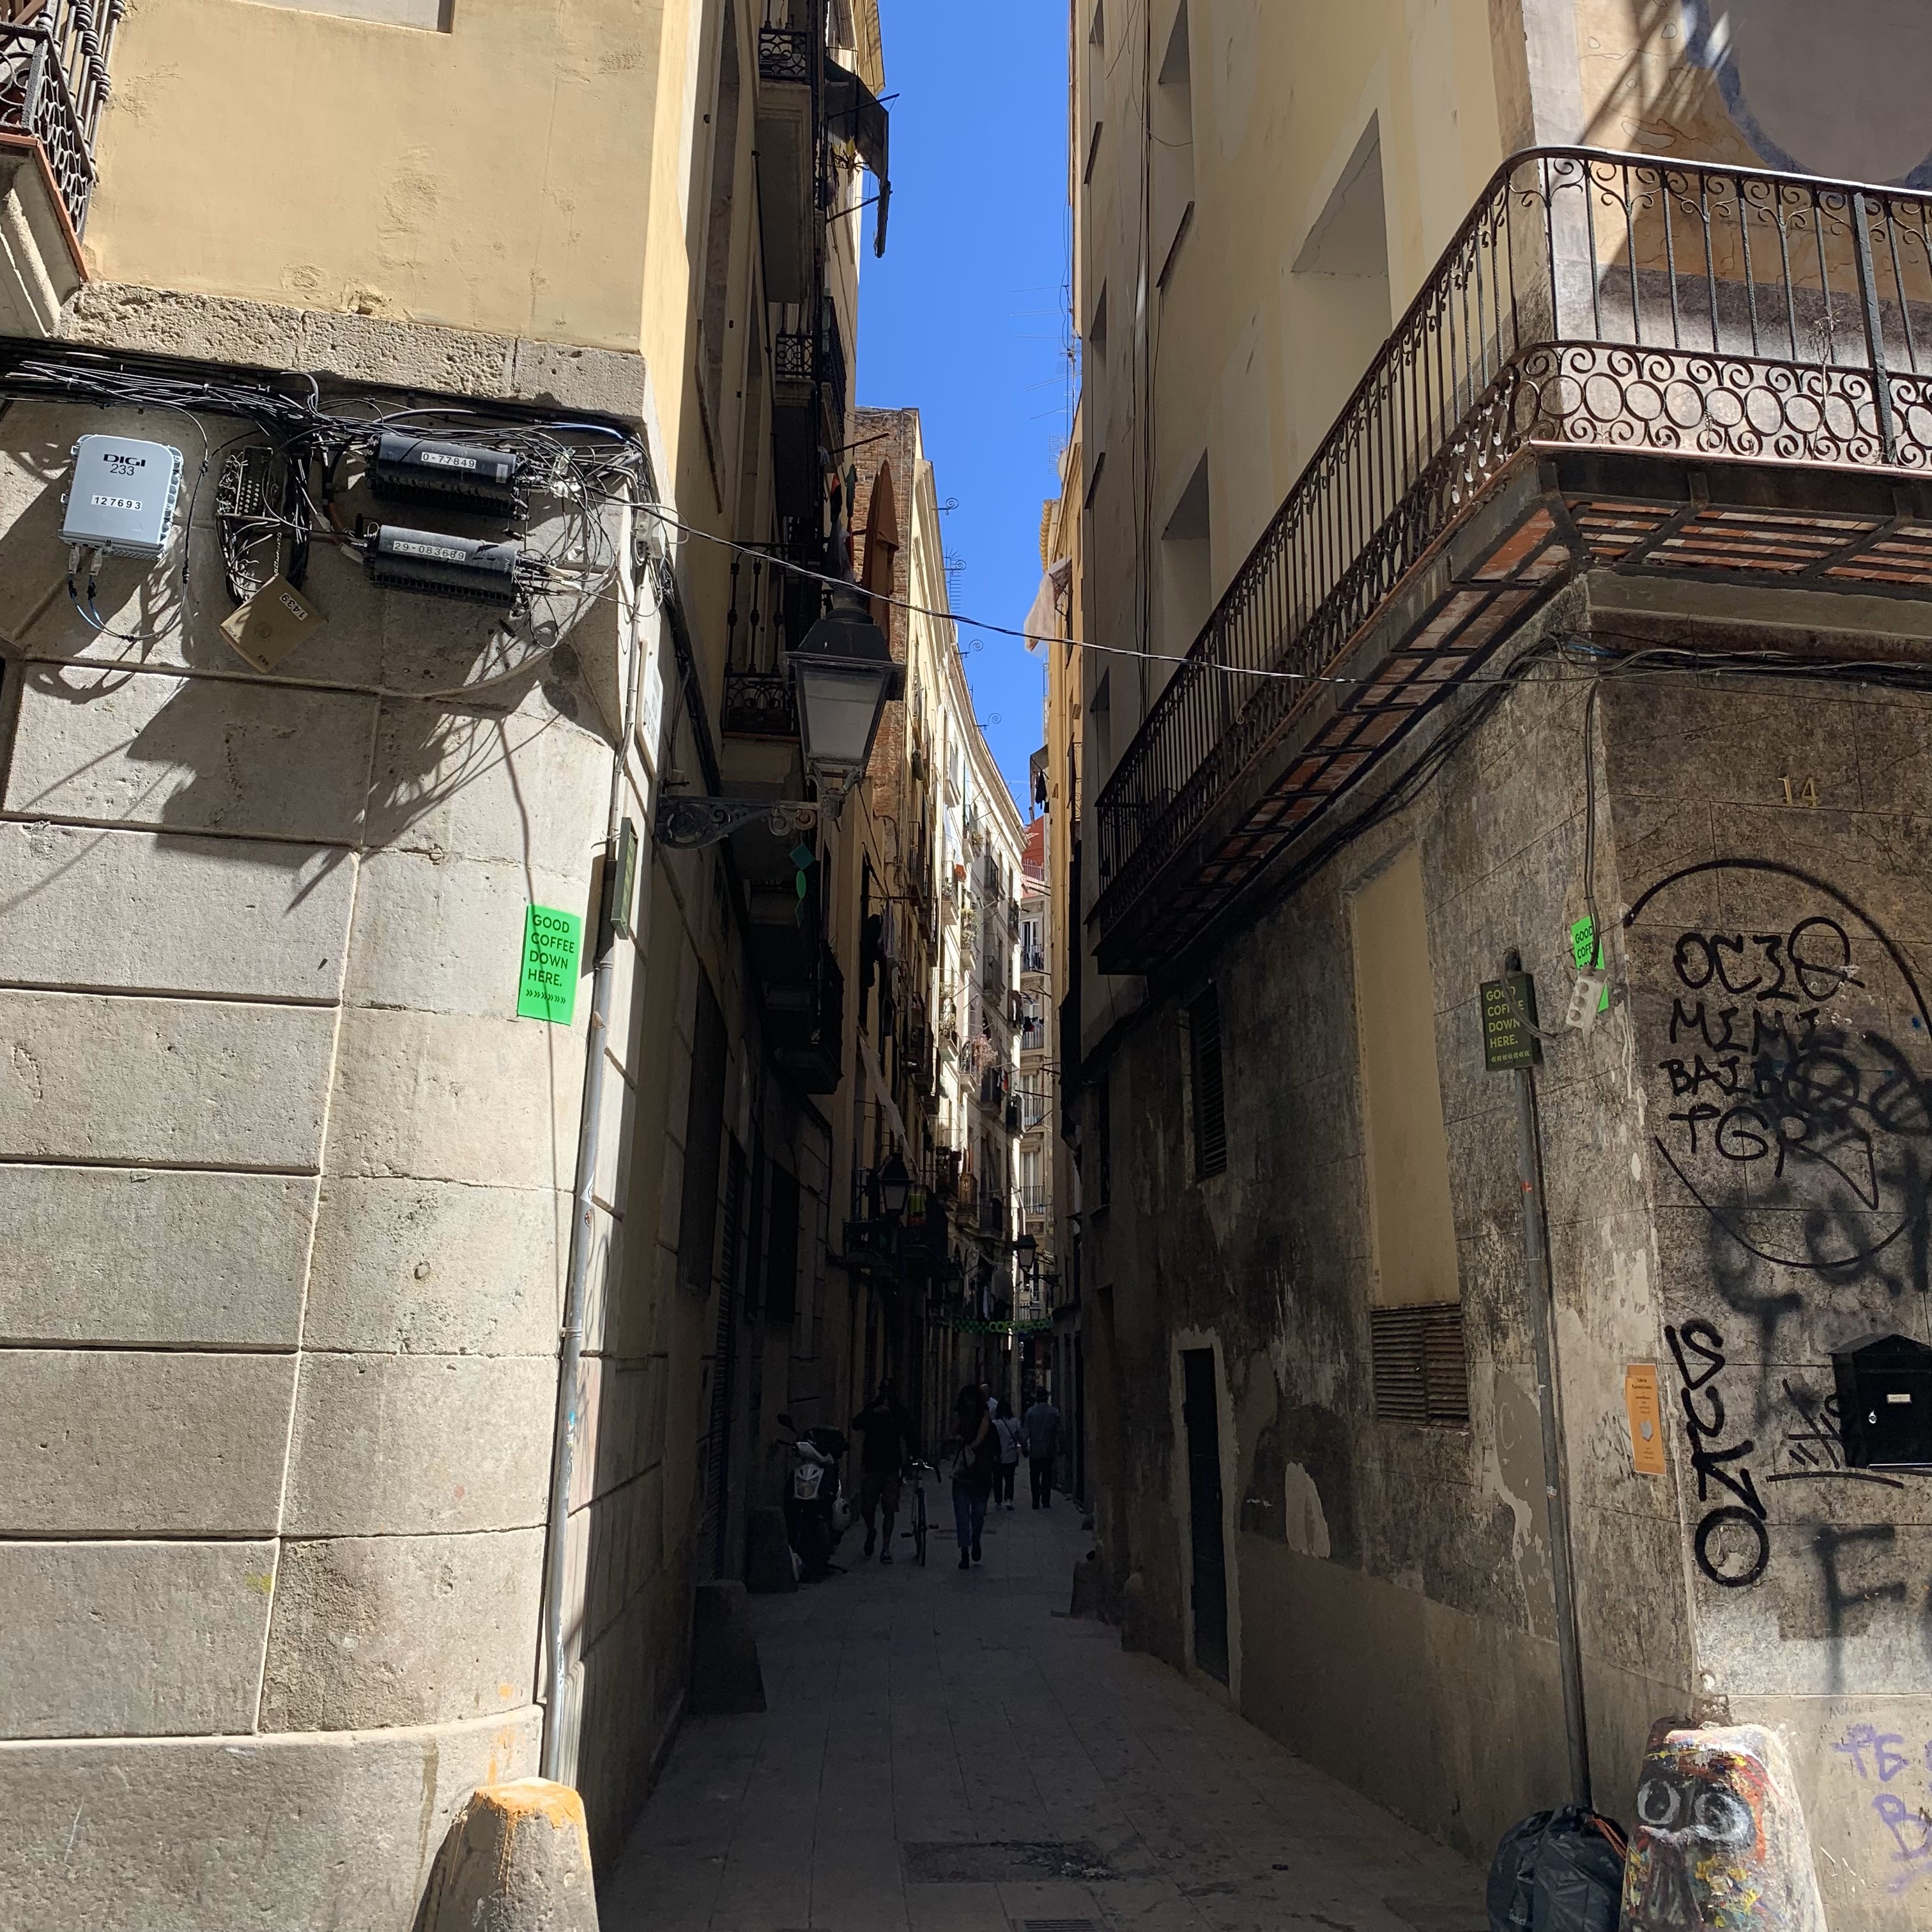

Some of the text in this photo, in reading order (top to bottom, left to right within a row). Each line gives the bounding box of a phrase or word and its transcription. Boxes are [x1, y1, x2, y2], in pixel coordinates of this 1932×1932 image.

[103, 454, 146, 467] DIGI
[110, 463, 135, 476] 233
[422, 453, 475, 468] 0-77849
[95, 496, 141, 510] 127693
[394, 542, 465, 560] 29-083689
[280, 594, 305, 619] 1439
[1777, 774, 1818, 808] 14
[532, 914, 569, 933] GOOD
[531, 932, 575, 954] COFFEE
[529, 950, 568, 970] DOWN
[528, 969, 562, 987] HERE.
[1488, 1018, 1521, 1033] DOWN
[1489, 1034, 1519, 1048] HERE.
